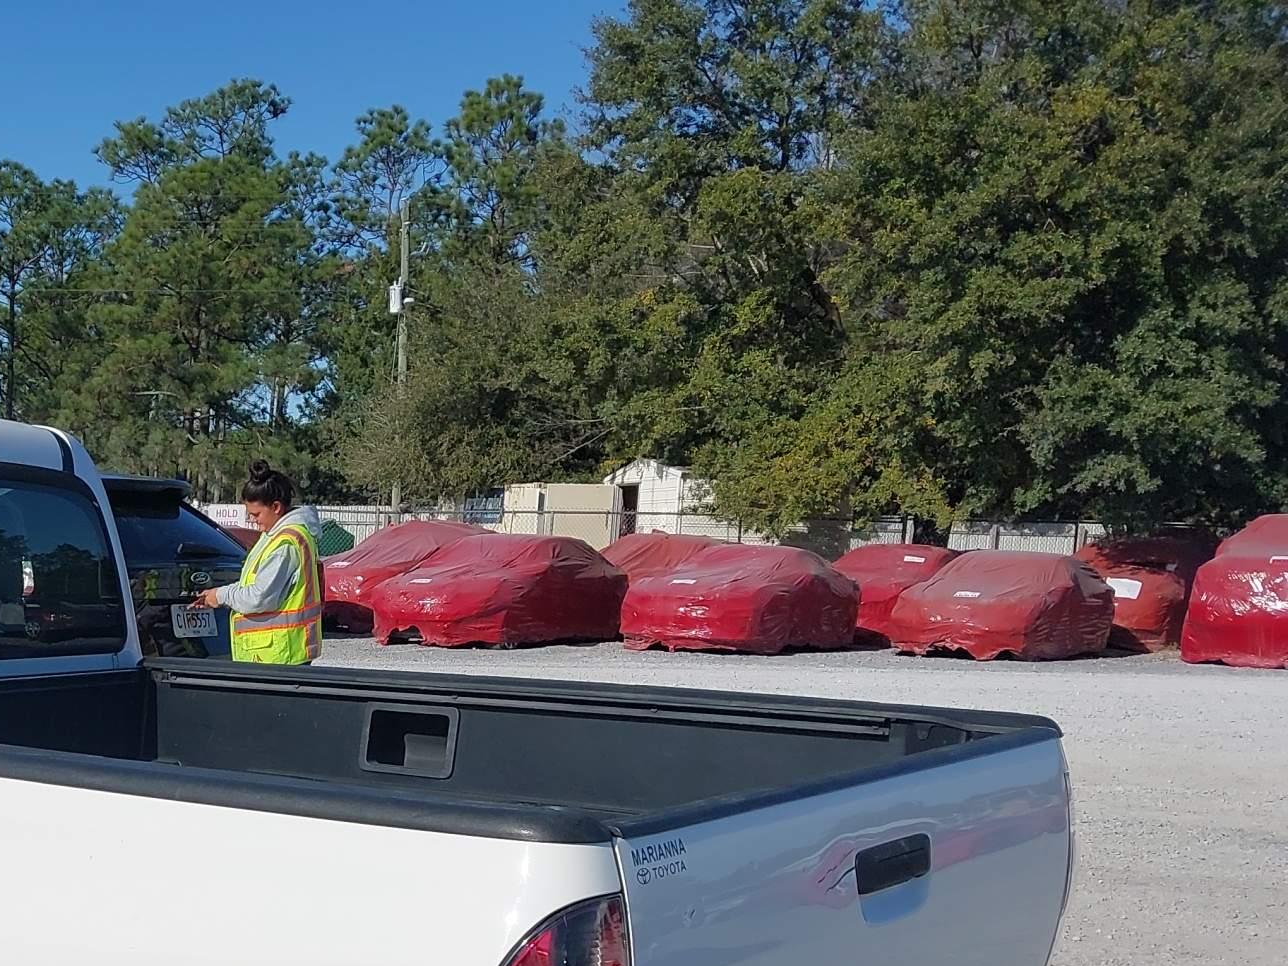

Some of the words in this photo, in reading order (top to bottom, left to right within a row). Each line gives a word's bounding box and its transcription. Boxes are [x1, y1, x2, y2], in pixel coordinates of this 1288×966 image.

[215, 508, 238, 518] HOLD
[631, 838, 687, 867] MARIANNA
[652, 860, 687, 880] TOYOTA
